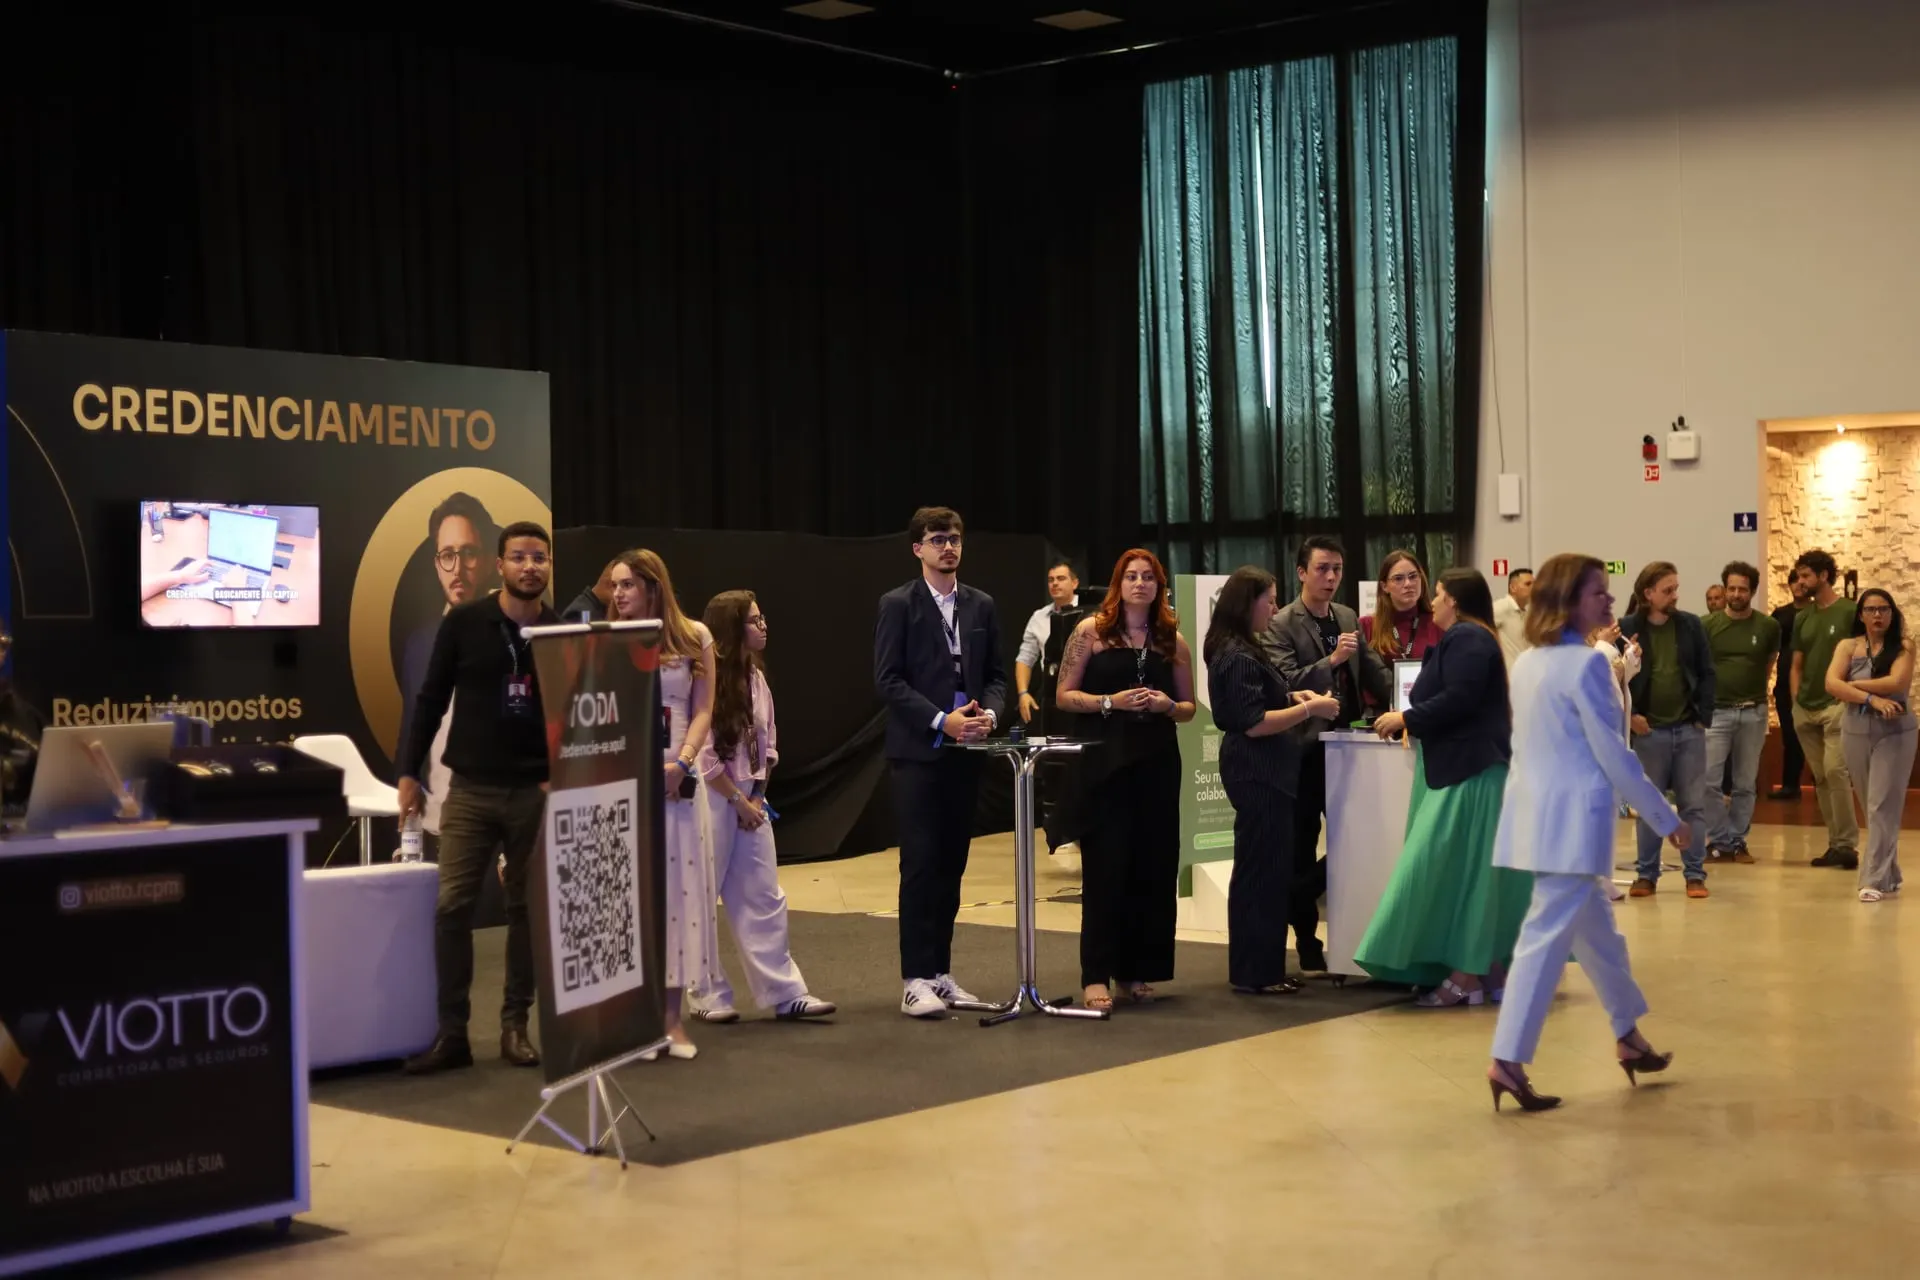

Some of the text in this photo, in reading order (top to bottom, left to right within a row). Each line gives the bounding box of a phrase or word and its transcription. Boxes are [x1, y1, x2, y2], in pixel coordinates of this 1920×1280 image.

[73, 383, 496, 450] CREDENCIAMENTO
[214, 589, 261, 600] BASICAMENTE
[53, 694, 163, 728] Reduzi
[1195, 769, 1211, 784] Seu
[57, 985, 269, 1060] VIOTTO
[56, 1060, 161, 1087] CORRETORA
[194, 1043, 269, 1066] SEGUROS
[27, 1151, 225, 1204] NA VIOTTO A ESCOLHA É SUA
